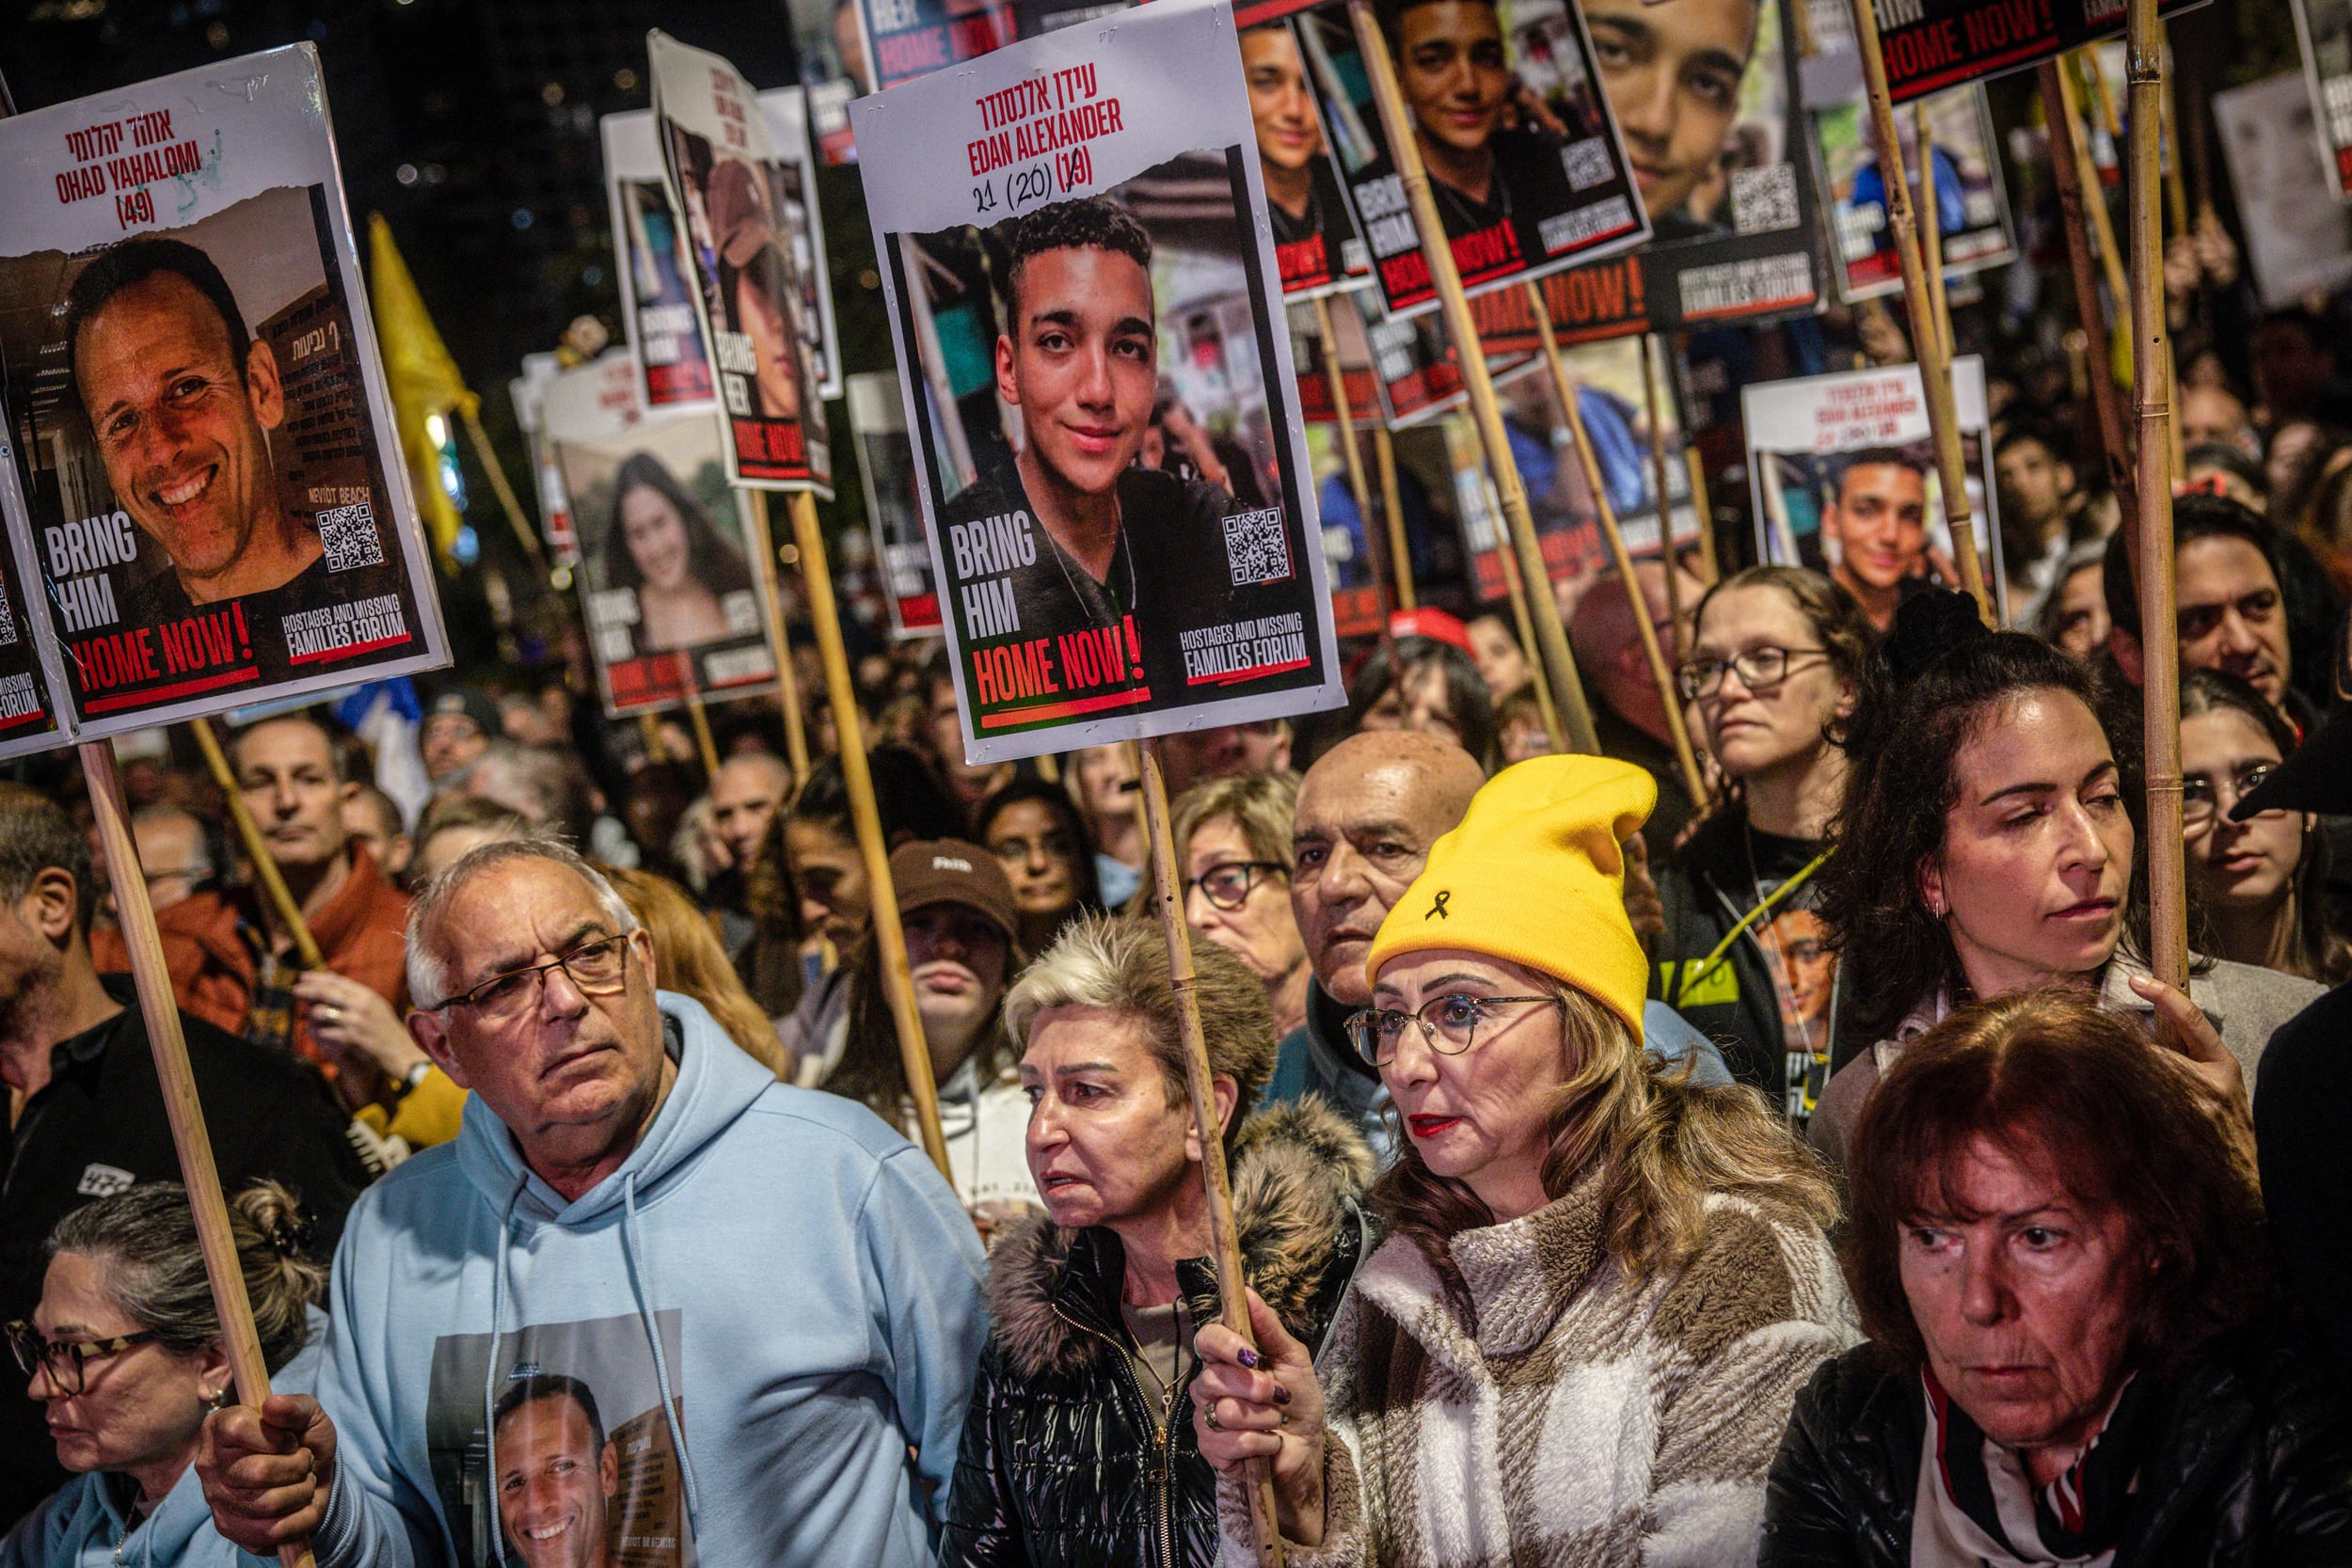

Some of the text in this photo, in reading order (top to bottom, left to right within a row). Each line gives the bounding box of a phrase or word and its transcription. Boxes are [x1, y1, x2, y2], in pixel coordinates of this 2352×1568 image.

[1880, 19, 1963, 84] HOME
[1963, 0, 2055, 55] NOW!
[976, 62, 1098, 132] עידן אלכסנדר
[65, 109, 175, 163] אוהד יהלומי
[967, 98, 1124, 177] EDAN ALEXANDER
[55, 140, 201, 204] OHAD YAHALOMI
[973, 179, 998, 214] 21
[115, 188, 155, 230] (49)
[1543, 255, 1645, 326] NOW!
[340, 485, 370, 505] BEACH
[45, 511, 137, 578] BRING
[950, 510, 1037, 580] BRING
[56, 573, 119, 633] HIM
[282, 593, 402, 634] HOSTAGES AND MISSING
[286, 610, 406, 657] FAMILIES FORUM
[961, 577, 1021, 641] HIM
[1180, 624, 1234, 651] HOSTAGES
[1234, 620, 1257, 641] AND
[1256, 611, 1303, 639] MISSING
[72, 601, 253, 693] HOME NOW!
[973, 614, 1145, 705] HOME NOW!
[1184, 631, 1307, 678] FAMILIES FORUM
